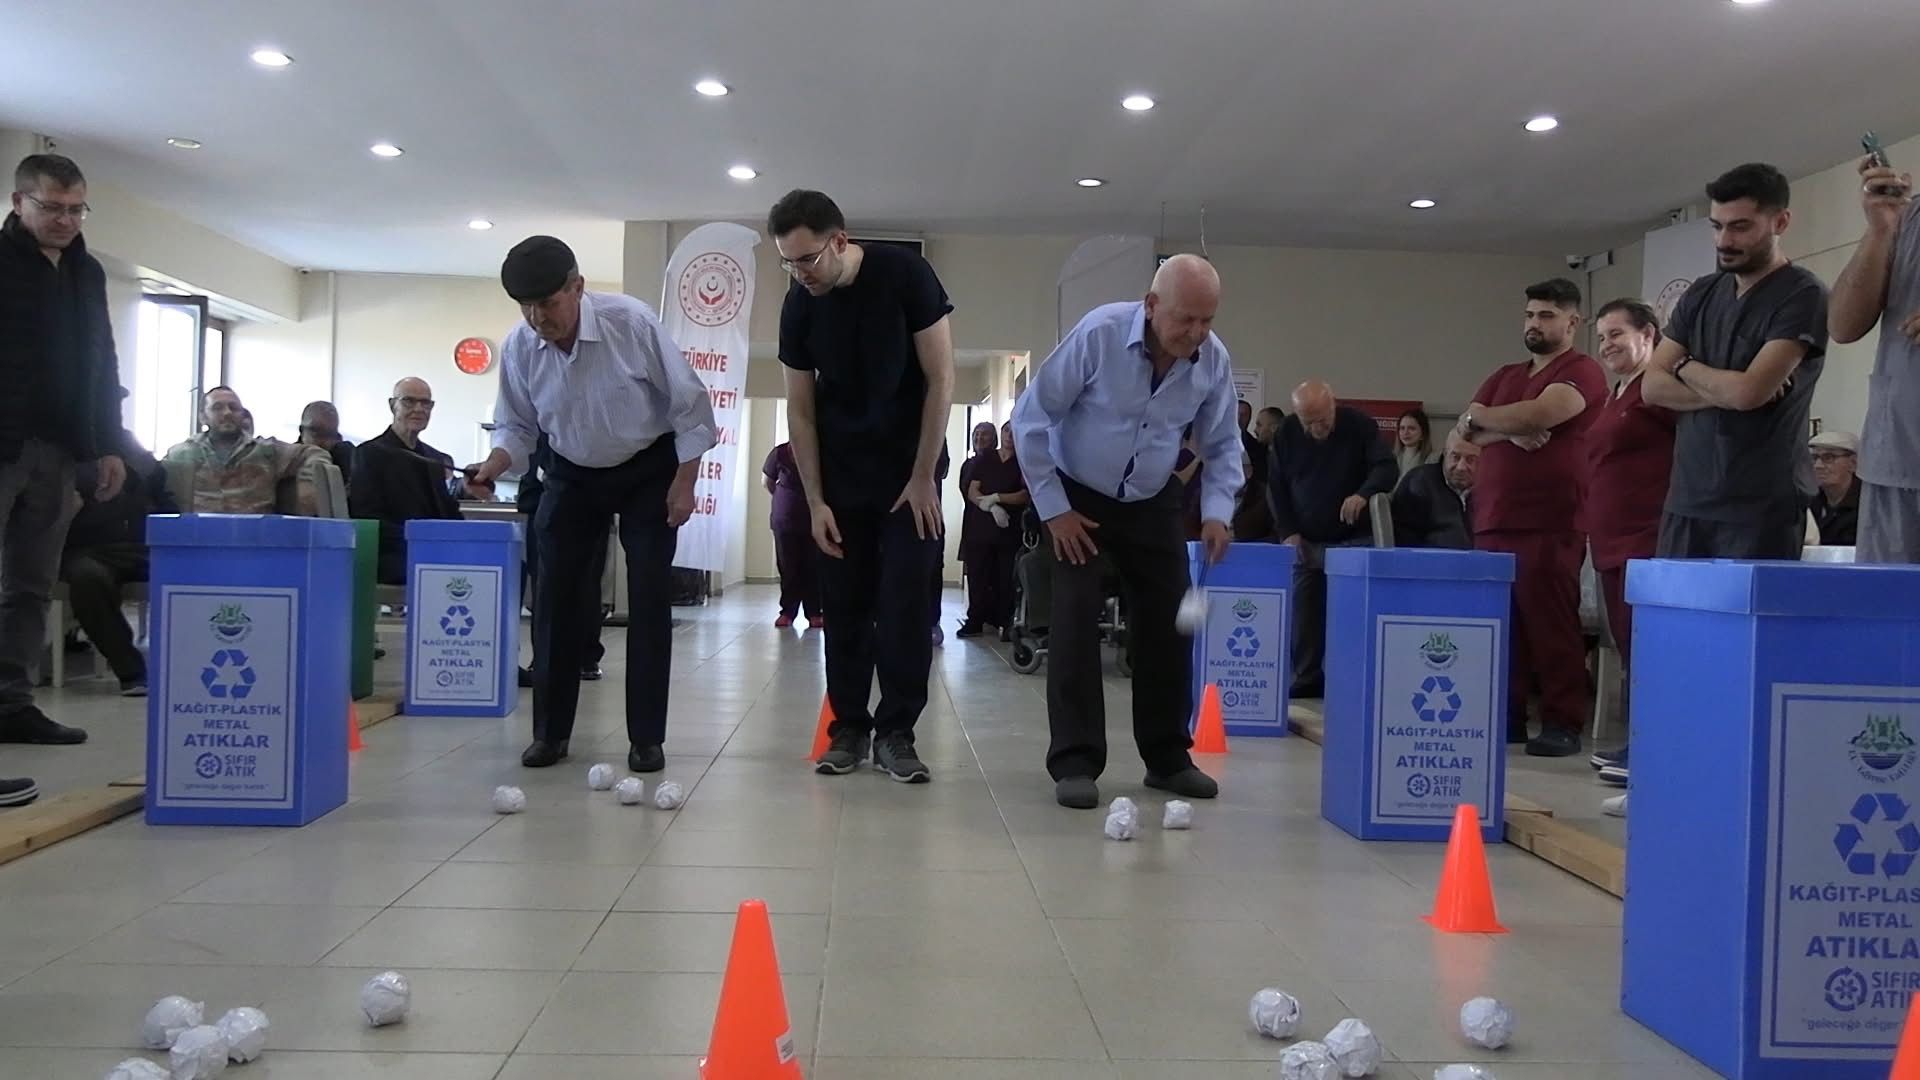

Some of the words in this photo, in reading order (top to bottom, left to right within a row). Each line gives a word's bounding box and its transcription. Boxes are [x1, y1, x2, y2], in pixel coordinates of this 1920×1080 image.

[429, 658, 483, 668] ATIKLAR
[1217, 679, 1268, 689] ATIKLAR
[204, 719, 251, 729] METAL
[184, 733, 269, 748] ATIKLAR
[1414, 741, 1457, 752] METAL
[224, 754, 256, 765] SIFIR
[1396, 755, 1473, 769] ATIKLAR
[224, 766, 256, 777] ATIK
[1433, 775, 1461, 785] SIFIR
[1433, 786, 1461, 797] ATIK
[1789, 881, 1920, 903] KAĞIT-PLAS
[1838, 911, 1913, 928] METAL
[1805, 935, 1920, 959] ATIKLA
[1871, 971, 1920, 989] SIFIR
